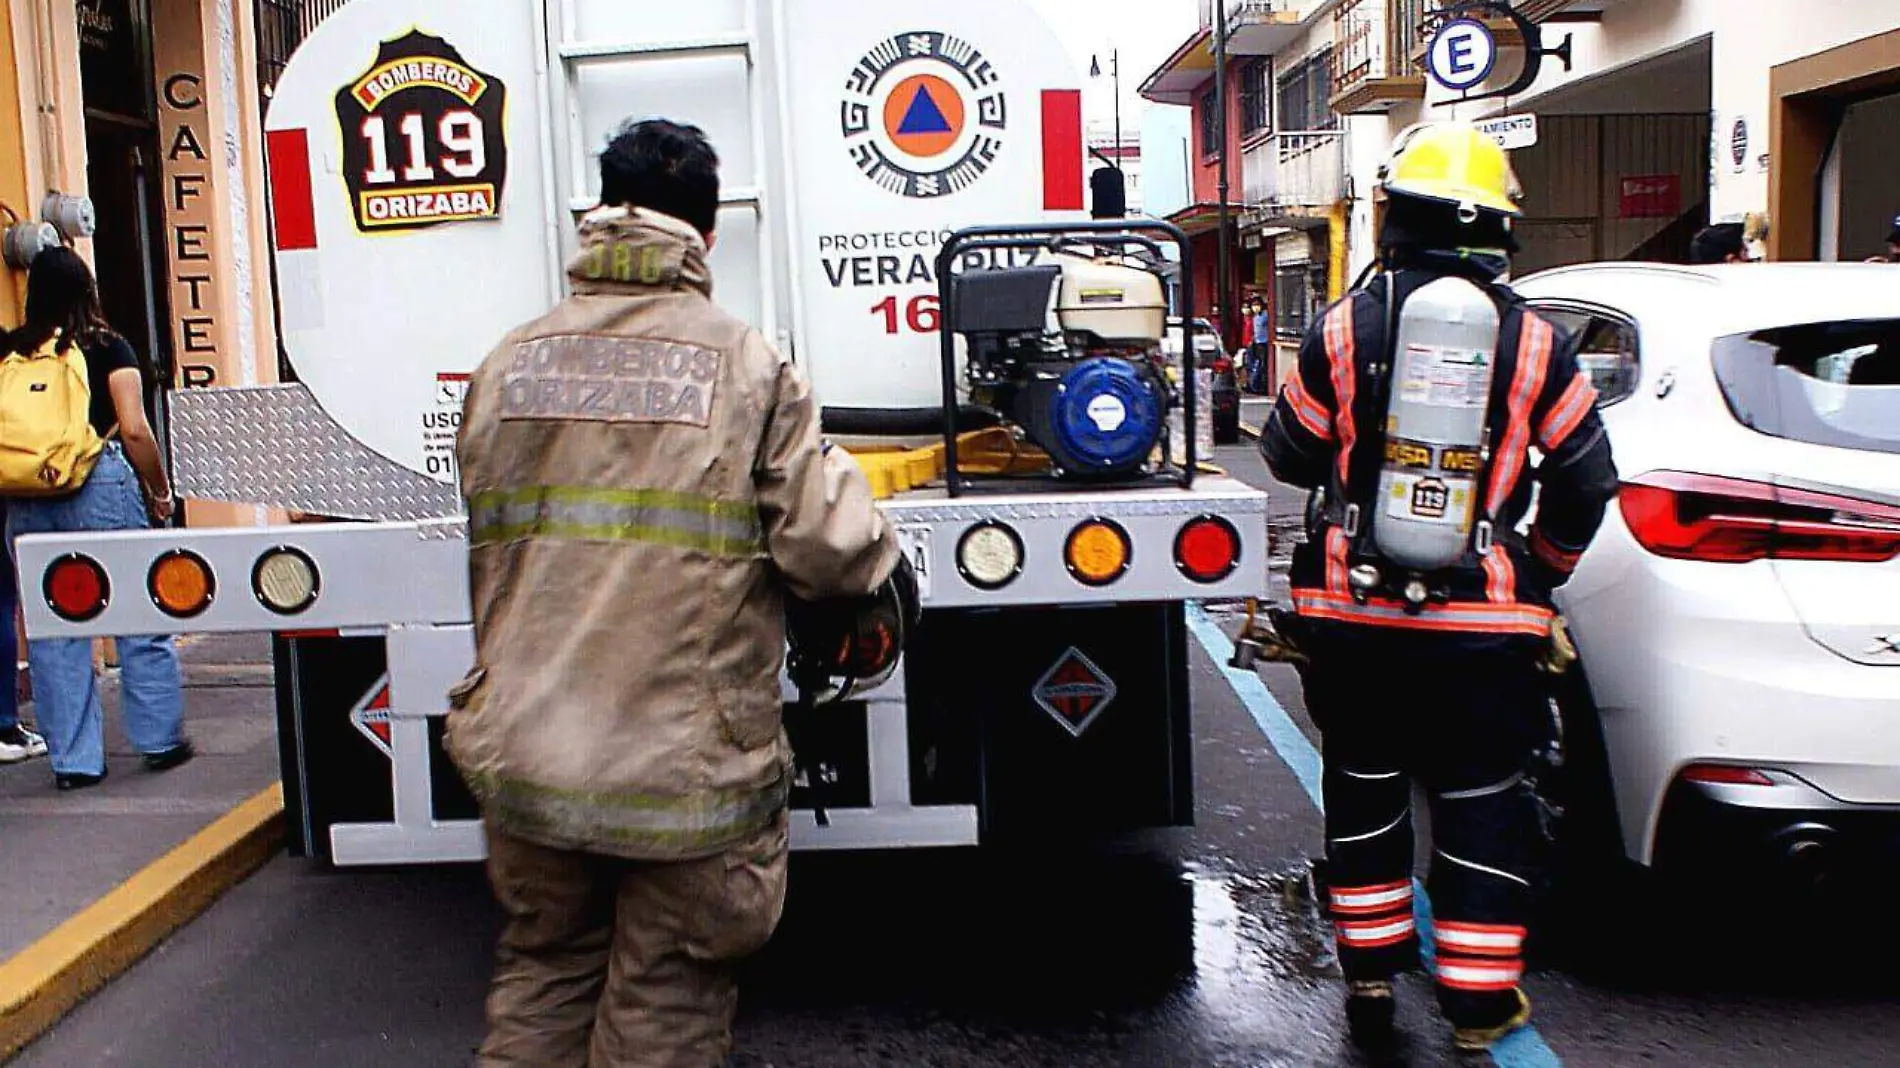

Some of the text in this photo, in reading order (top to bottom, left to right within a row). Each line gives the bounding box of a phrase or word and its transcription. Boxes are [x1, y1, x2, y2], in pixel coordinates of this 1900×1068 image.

[1448, 34, 1474, 74] E
[366, 62, 474, 98] BOMBEROS
[362, 111, 486, 183] 119
[369, 191, 488, 218] ORIZABA
[819, 226, 955, 250] PROTECCIÓ
